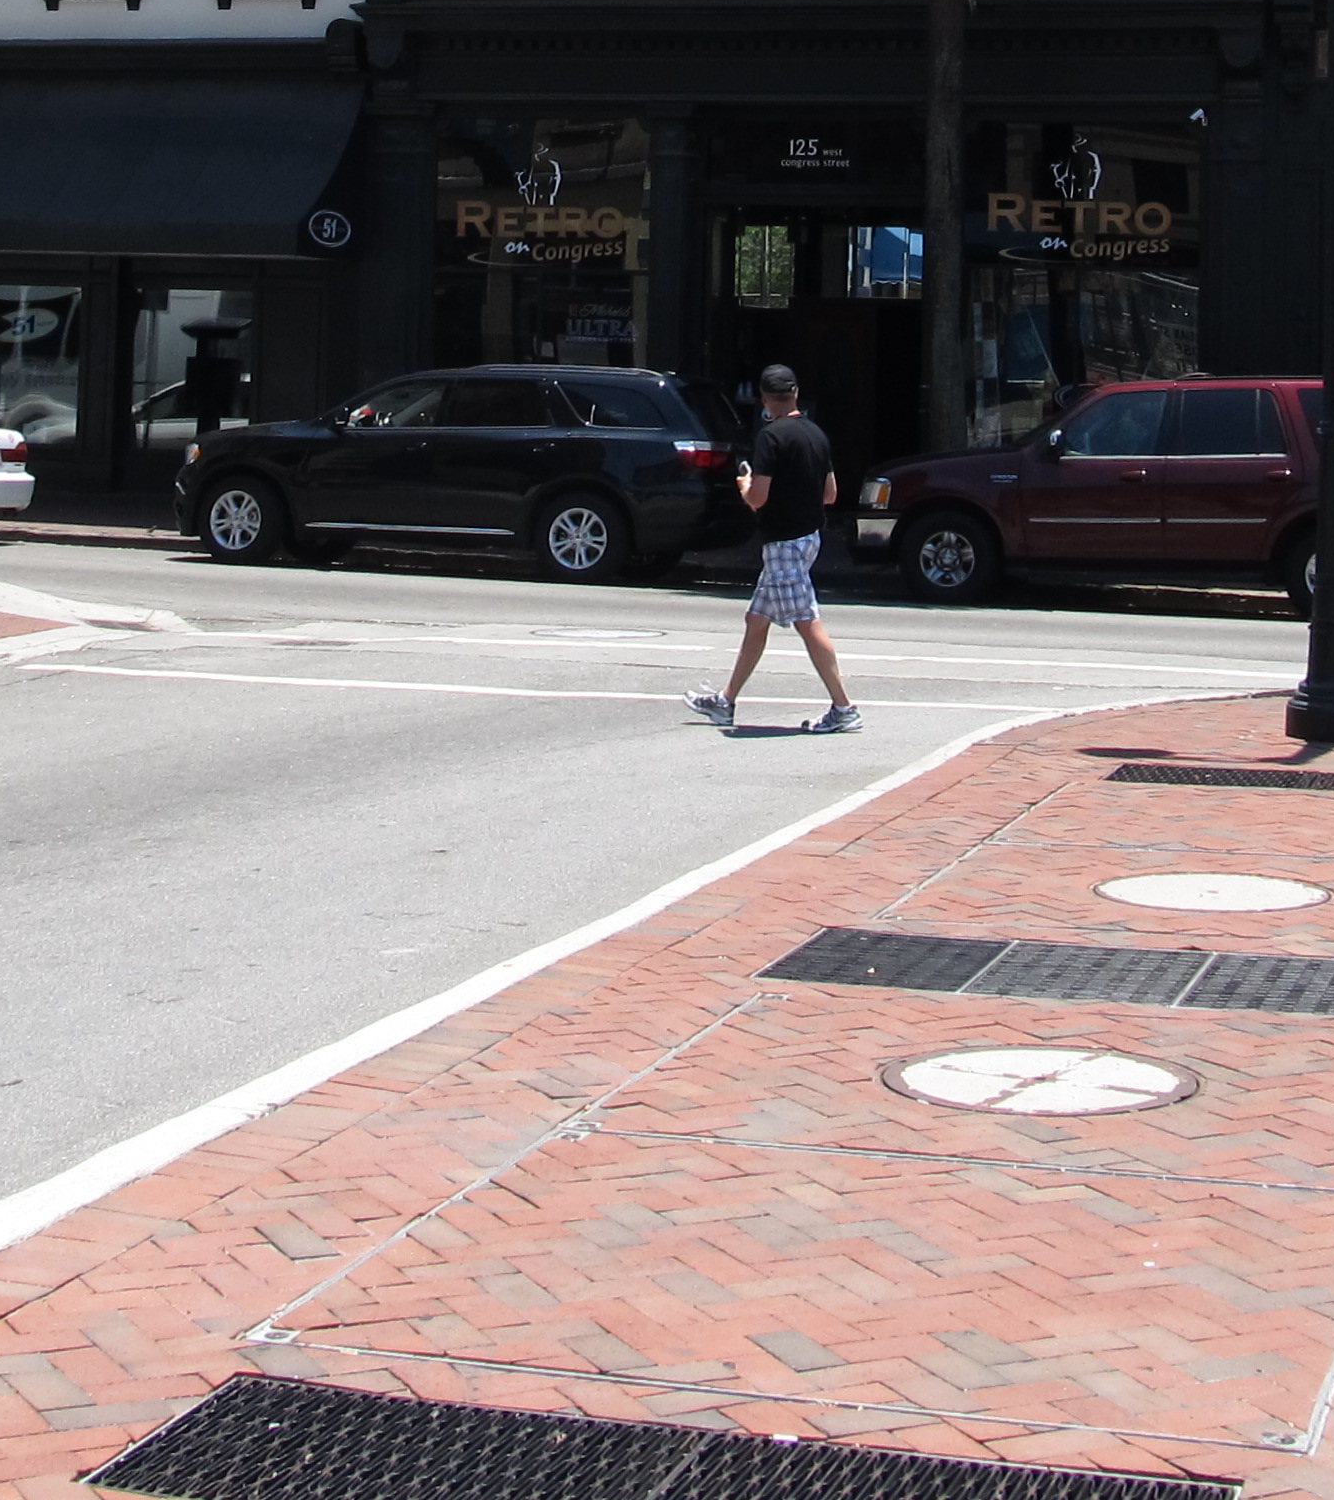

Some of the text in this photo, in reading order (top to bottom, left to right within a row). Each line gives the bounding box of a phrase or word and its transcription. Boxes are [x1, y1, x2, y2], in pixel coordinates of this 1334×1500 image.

[789, 139, 818, 156] 125
[780, 160, 820, 168] congress
[455, 200, 625, 239] RETRO
[987, 192, 1172, 236] RETRO
[322, 218, 337, 238] 51
[503, 241, 623, 264] on Congress
[1039, 236, 1170, 260] on Congress
[566, 319, 638, 337] ULTRA
